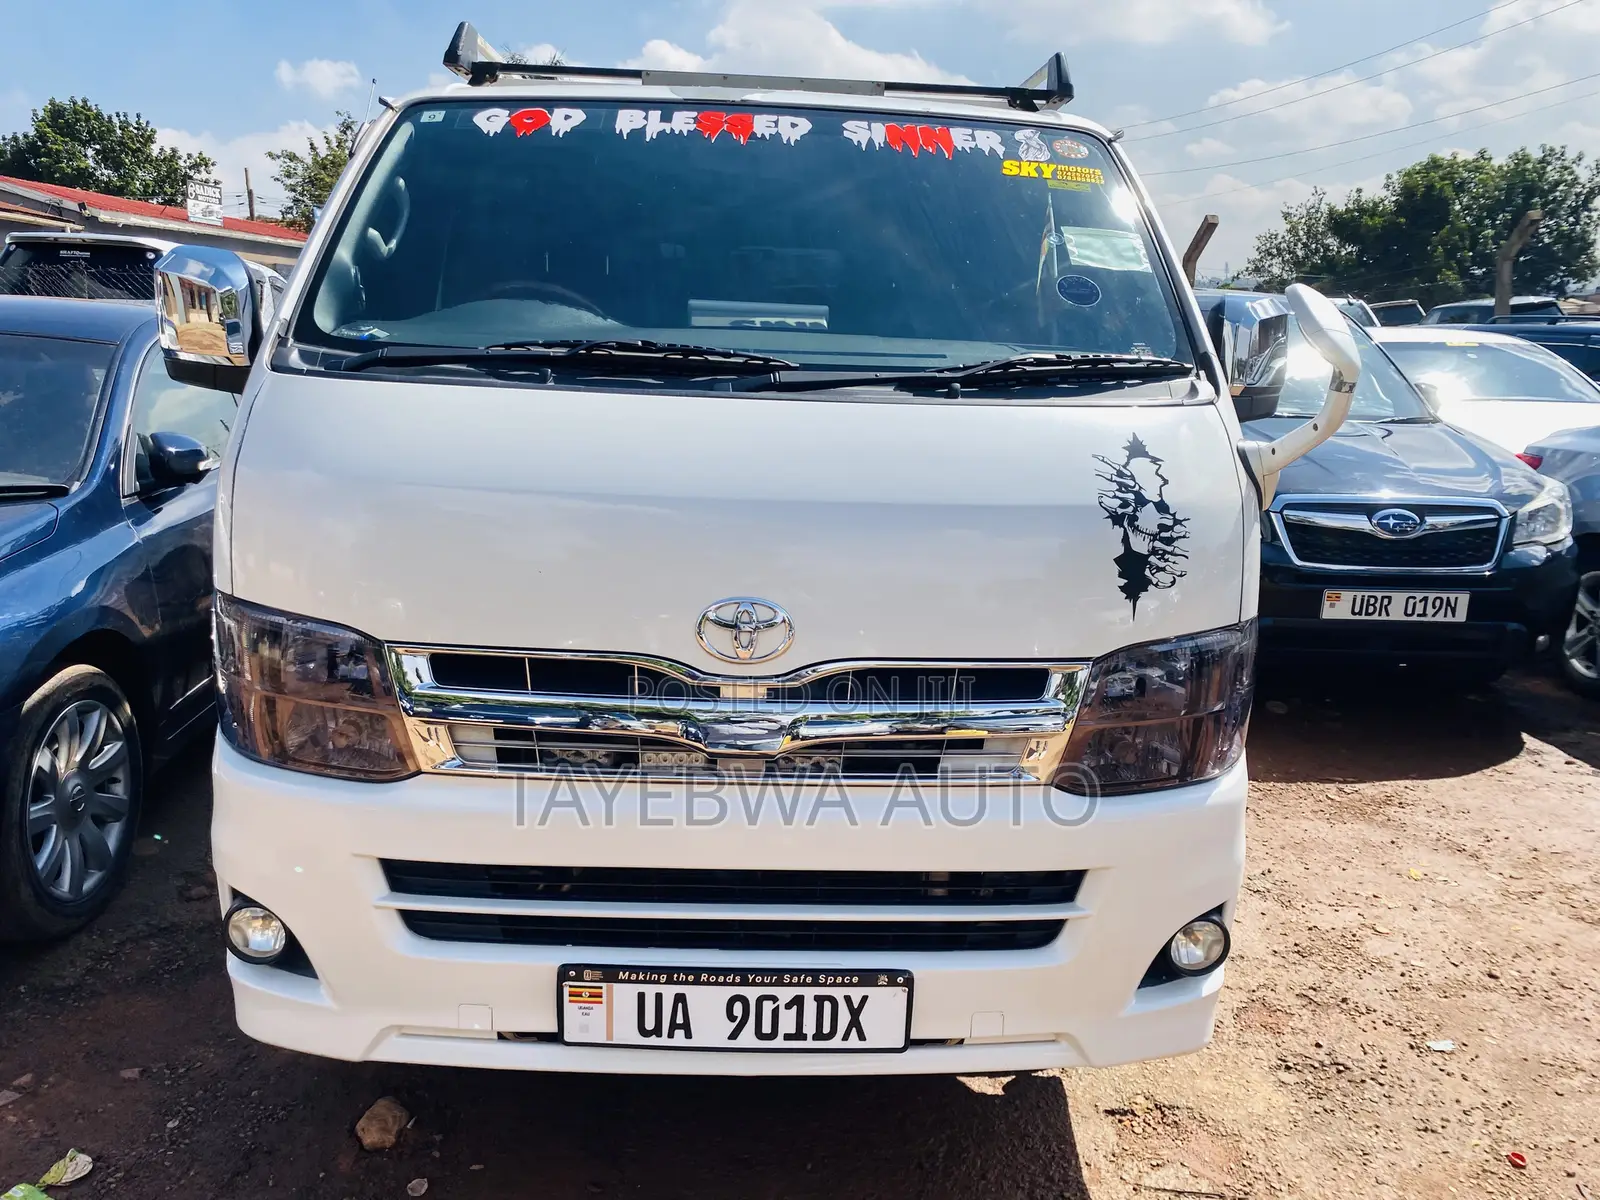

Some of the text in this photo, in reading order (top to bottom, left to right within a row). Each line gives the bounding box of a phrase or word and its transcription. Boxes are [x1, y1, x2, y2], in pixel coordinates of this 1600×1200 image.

[472, 107, 1006, 160] GOD BLESSED SINNER
[1002, 159, 1056, 180] SKY
[1056, 164, 1102, 176] motors
[195, 184, 221, 199] SADICK
[1350, 594, 1459, 618] UBR 019N
[618, 971, 859, 985] Making the Roads Your Safe Space
[637, 991, 869, 1042] UA 901DX
